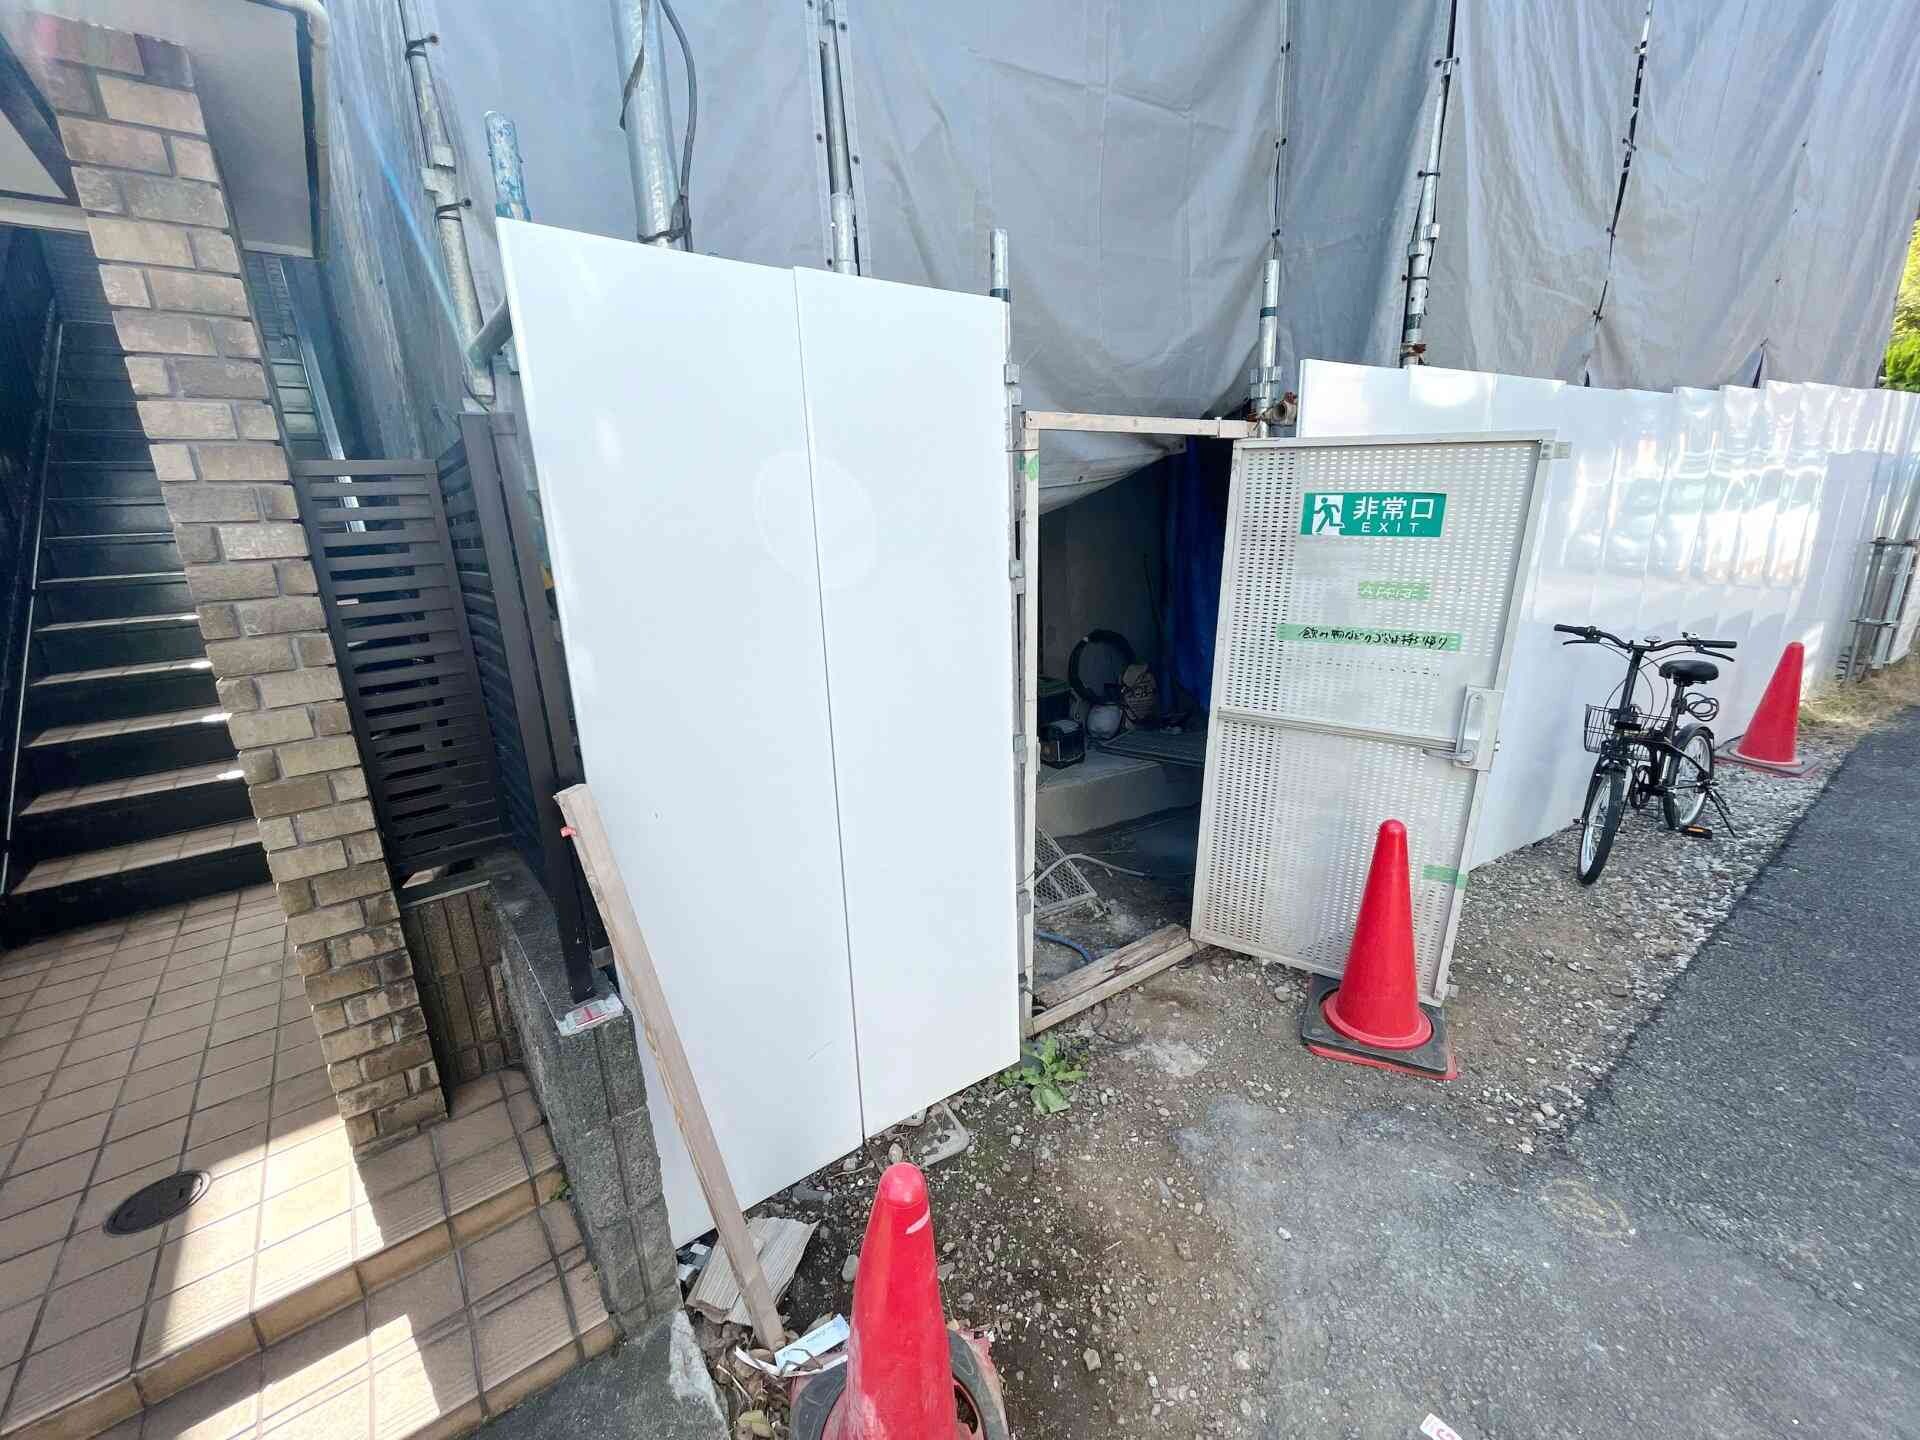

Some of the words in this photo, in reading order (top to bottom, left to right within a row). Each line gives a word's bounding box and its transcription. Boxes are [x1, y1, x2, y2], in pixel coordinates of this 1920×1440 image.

[1353, 496, 1434, 520] 非常口
[1361, 522, 1420, 533] EXIT
